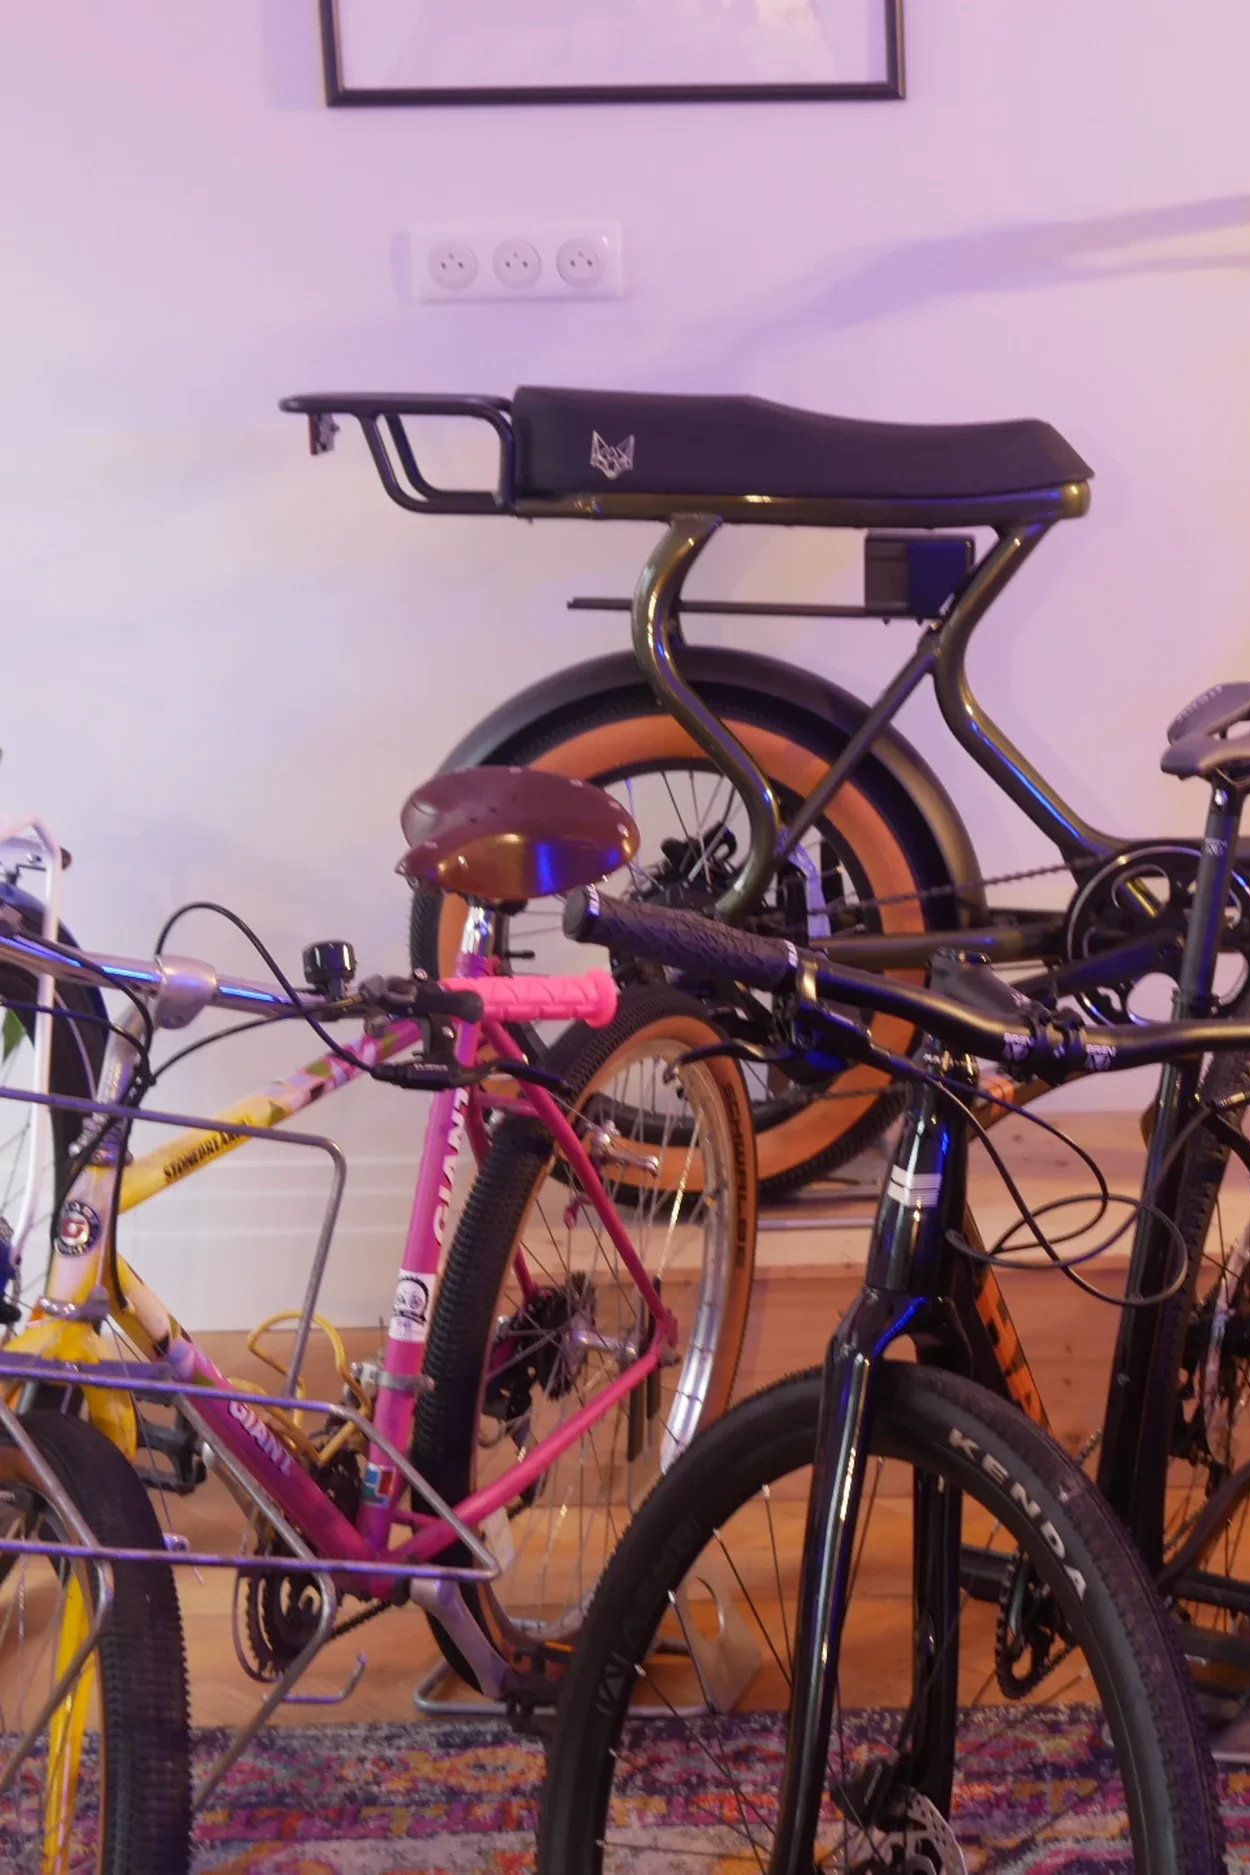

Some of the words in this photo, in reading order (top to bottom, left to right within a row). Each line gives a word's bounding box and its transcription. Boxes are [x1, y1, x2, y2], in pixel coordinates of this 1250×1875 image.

[723, 1082, 748, 1268] SCHWALBE
[228, 1399, 294, 1478] GIANT
[948, 1427, 1087, 1601] KENDA
